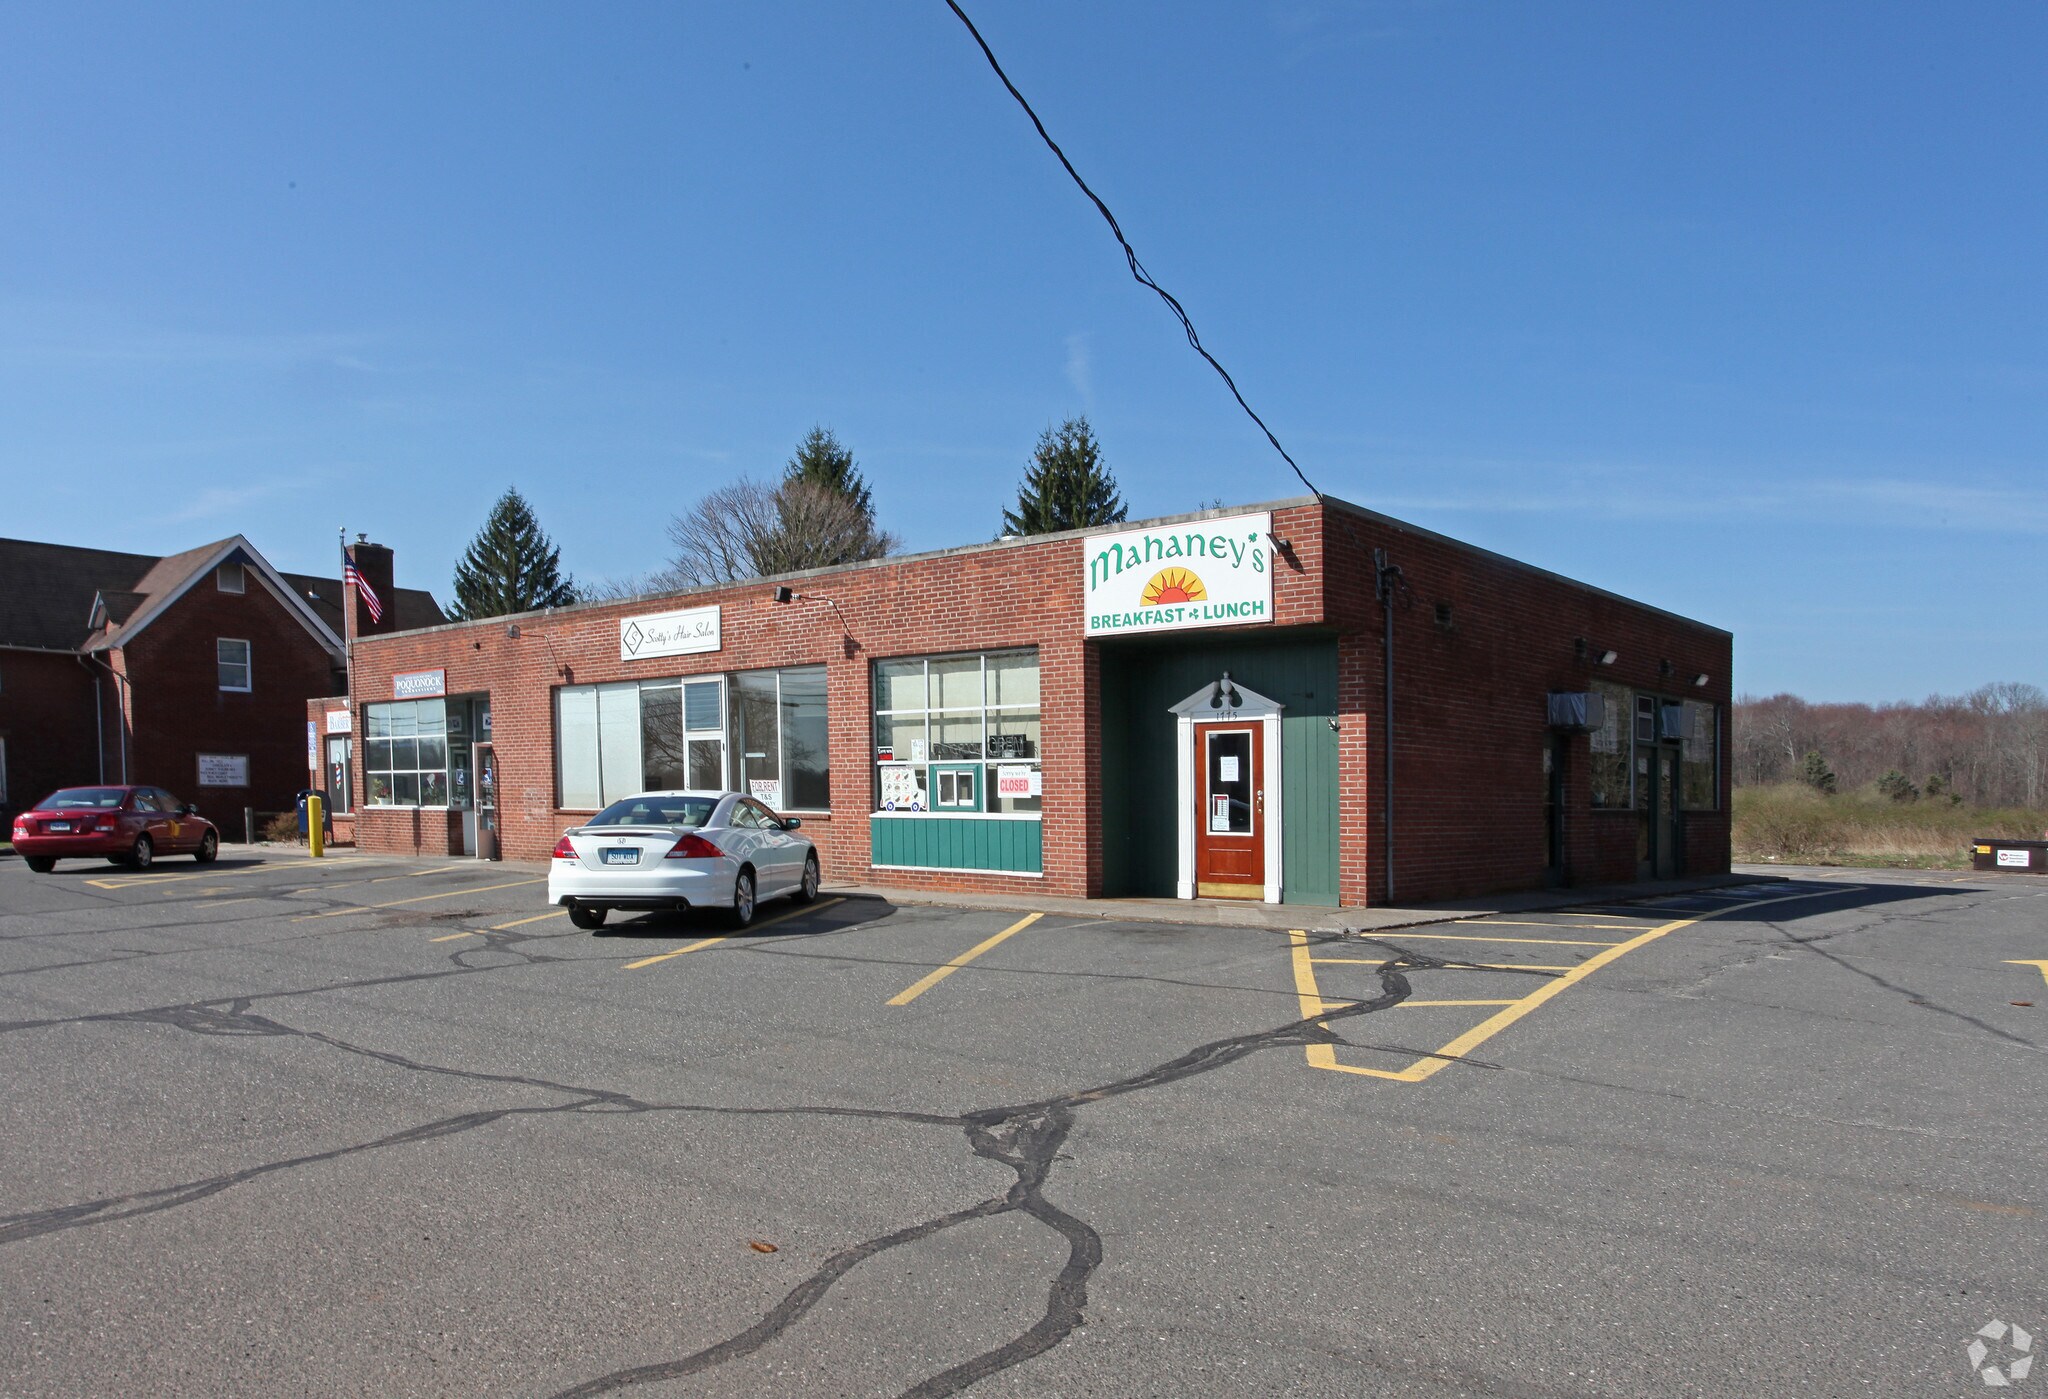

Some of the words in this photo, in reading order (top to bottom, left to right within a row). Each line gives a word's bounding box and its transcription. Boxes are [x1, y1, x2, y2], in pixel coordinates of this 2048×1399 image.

[1090, 532, 1265, 592] Mahaney's
[1091, 607, 1185, 630] BREAKFAST
[1203, 600, 1265, 620] LUNCH
[673, 624, 692, 641] Hair
[693, 621, 715, 638] Salon
[396, 676, 442, 690] POQUONOCK
[1000, 779, 1029, 792] CLOSED
